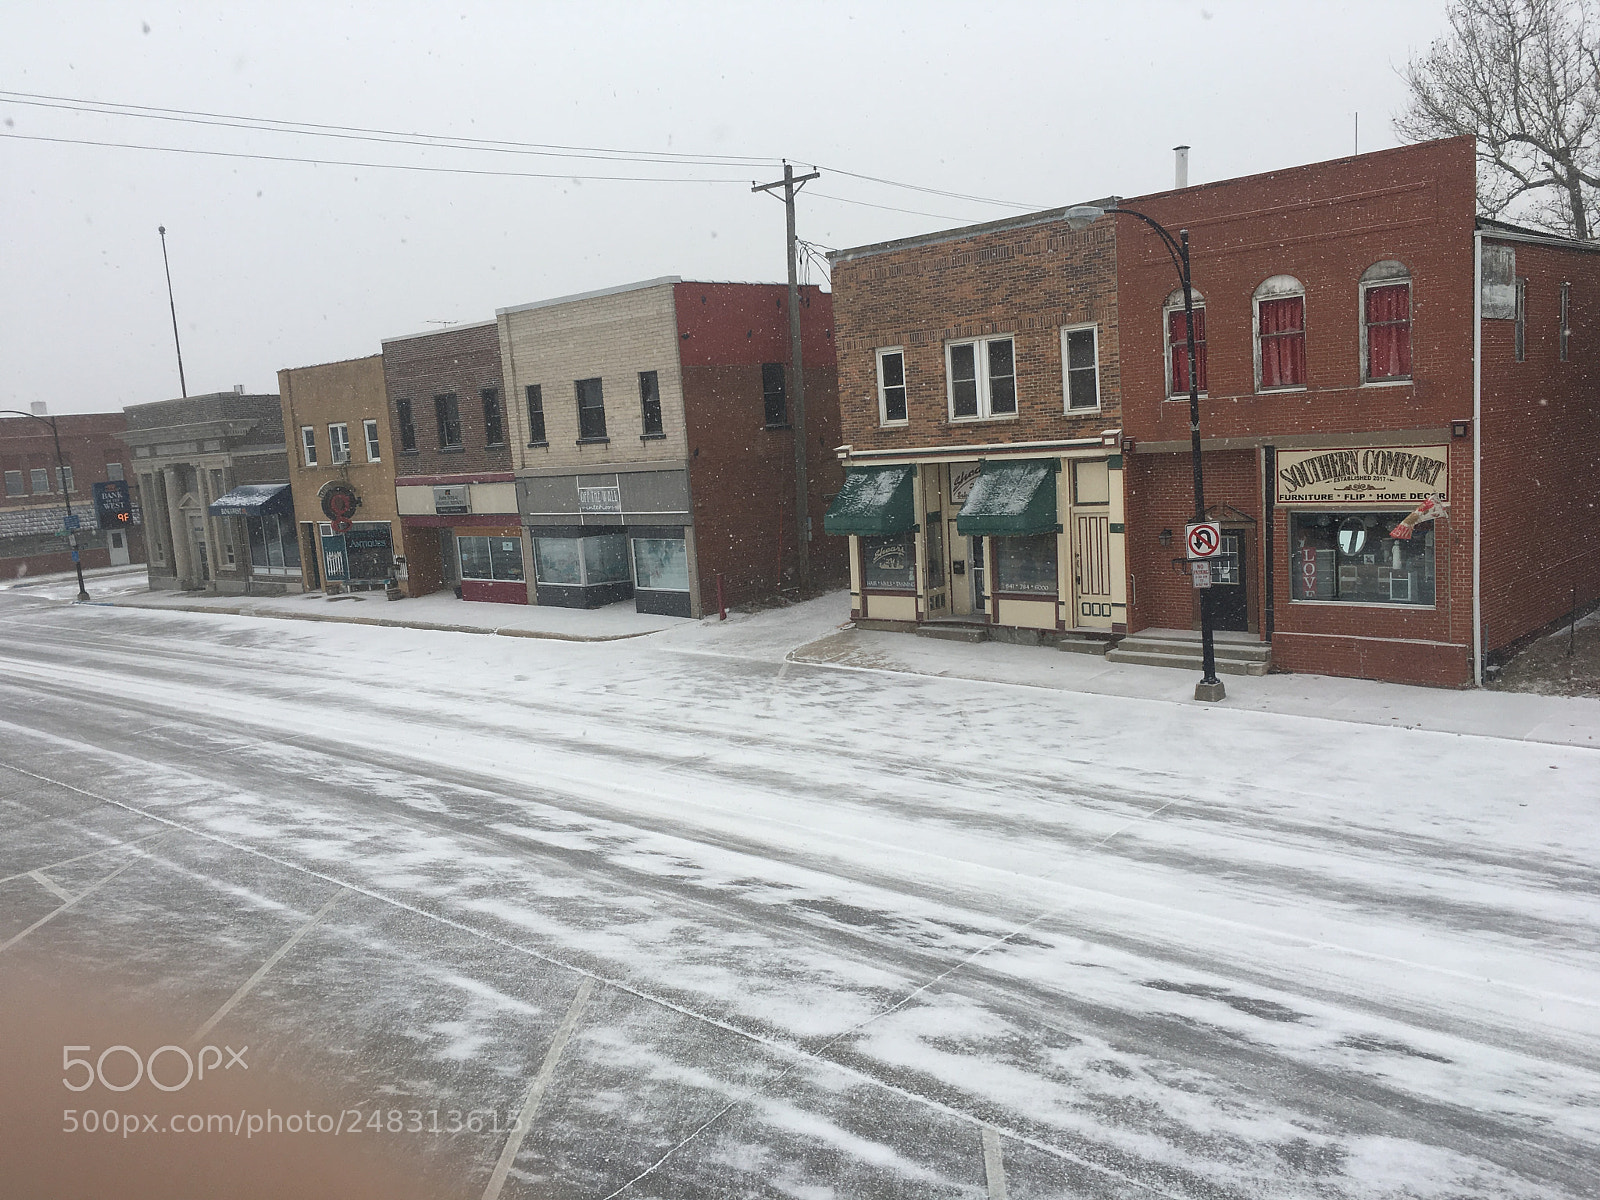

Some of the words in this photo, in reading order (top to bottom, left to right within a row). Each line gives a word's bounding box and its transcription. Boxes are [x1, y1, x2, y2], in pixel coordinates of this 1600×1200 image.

[1279, 450, 1360, 494] SOUTHERN
[1362, 449, 1447, 487] COMFORT
[1333, 475, 1372, 483] ESTABLISHED
[101, 491, 123, 500] BANK
[1279, 493, 1334, 501] FURNITURE
[1344, 493, 1366, 501] FLIP
[1409, 492, 1447, 500] DECR
[103, 501, 125, 510] WEST
